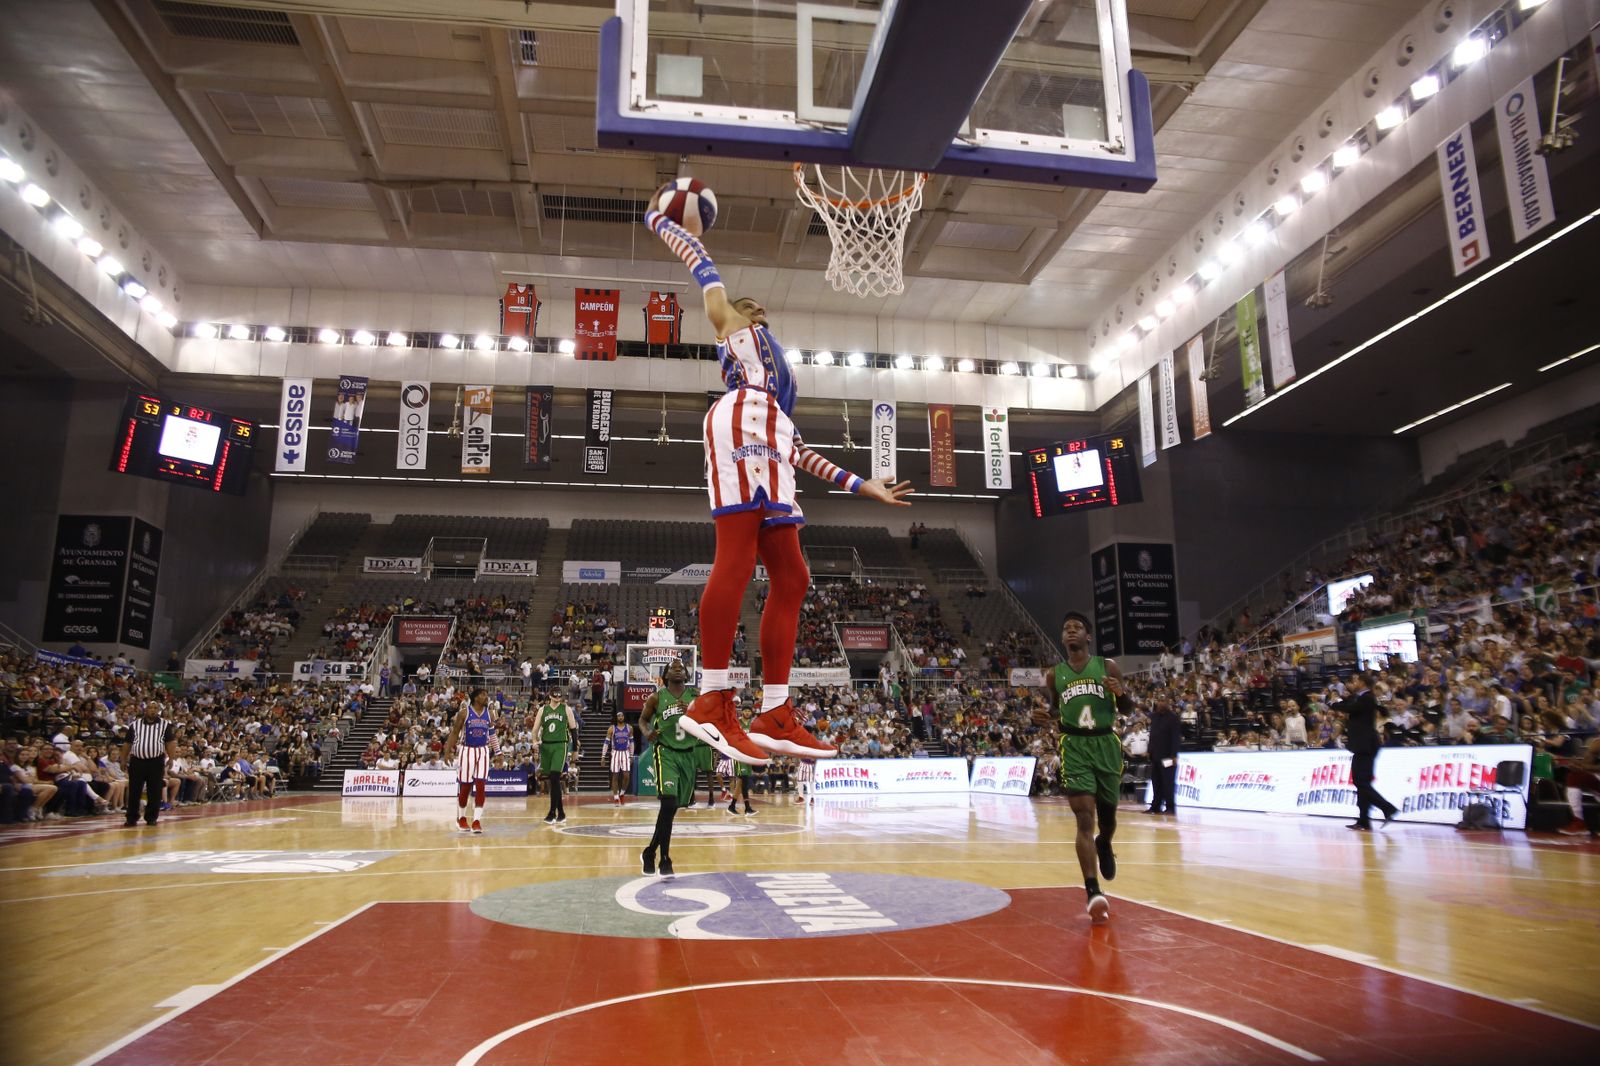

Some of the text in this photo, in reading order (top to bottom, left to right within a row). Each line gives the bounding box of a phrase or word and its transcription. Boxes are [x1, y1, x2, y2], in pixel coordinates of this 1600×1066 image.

[1446, 133, 1477, 240] BERNER
[517, 297, 525, 305] 18
[580, 301, 614, 312] CAMPEÓN
[143, 402, 160, 415] 53
[284, 384, 306, 447] asisa
[591, 401, 601, 430] VERDAD
[598, 390, 612, 442] BURGERS
[236, 425, 250, 437] 35
[529, 392, 542, 463] framacar
[404, 413, 425, 466] otero
[467, 426, 490, 465] enPie
[881, 425, 894, 468] Cuerva
[1111, 439, 1124, 449] 35
[731, 444, 782, 463] GLOBETROTTERS
[944, 432, 953, 483] ANTONIO
[989, 427, 1003, 487] fertisac
[1034, 453, 1048, 464] 53
[367, 558, 418, 568] IDEAL
[483, 561, 533, 571] IDEAL
[650, 617, 665, 628] 24
[1061, 683, 1105, 704] GENERALS
[1078, 704, 1096, 730] 4
[548, 722, 556, 732] 0
[675, 722, 686, 741] 5
[353, 775, 389, 785] HARLEM
[824, 767, 869, 779] HARLEM
[1226, 773, 1272, 783] HARLEM
[1418, 762, 1498, 791] HARLEM
[345, 785, 395, 794] GLOBETROTTERS
[815, 779, 879, 790] GLOBETROTTERS
[745, 872, 898, 933] PULEVA
